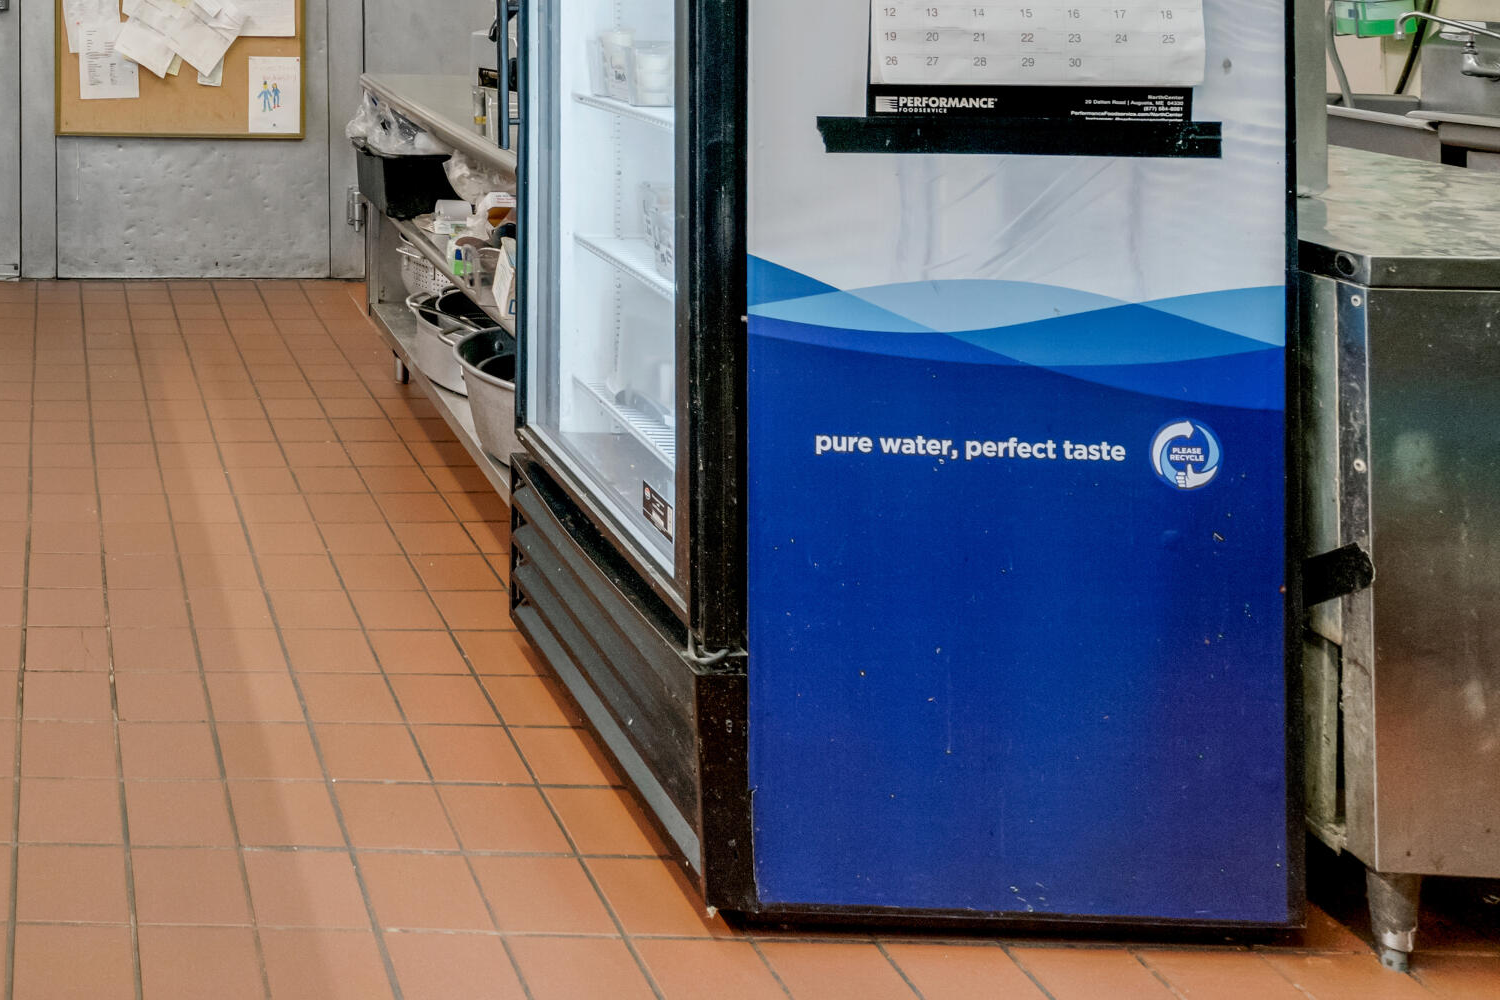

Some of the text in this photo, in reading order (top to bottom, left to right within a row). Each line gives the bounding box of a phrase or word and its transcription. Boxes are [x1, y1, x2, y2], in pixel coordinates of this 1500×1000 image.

[884, 8, 1172, 19] 12 13 14 15 16 17 18
[885, 32, 1175, 44] 19 20 21 22 23 24 25
[886, 56, 1081, 67] 26 27 28 29 30
[899, 96, 995, 108] PERFORMANCE
[815, 434, 1126, 462] pure water, perfect taste
[1169, 454, 1205, 462] RECYCLE
